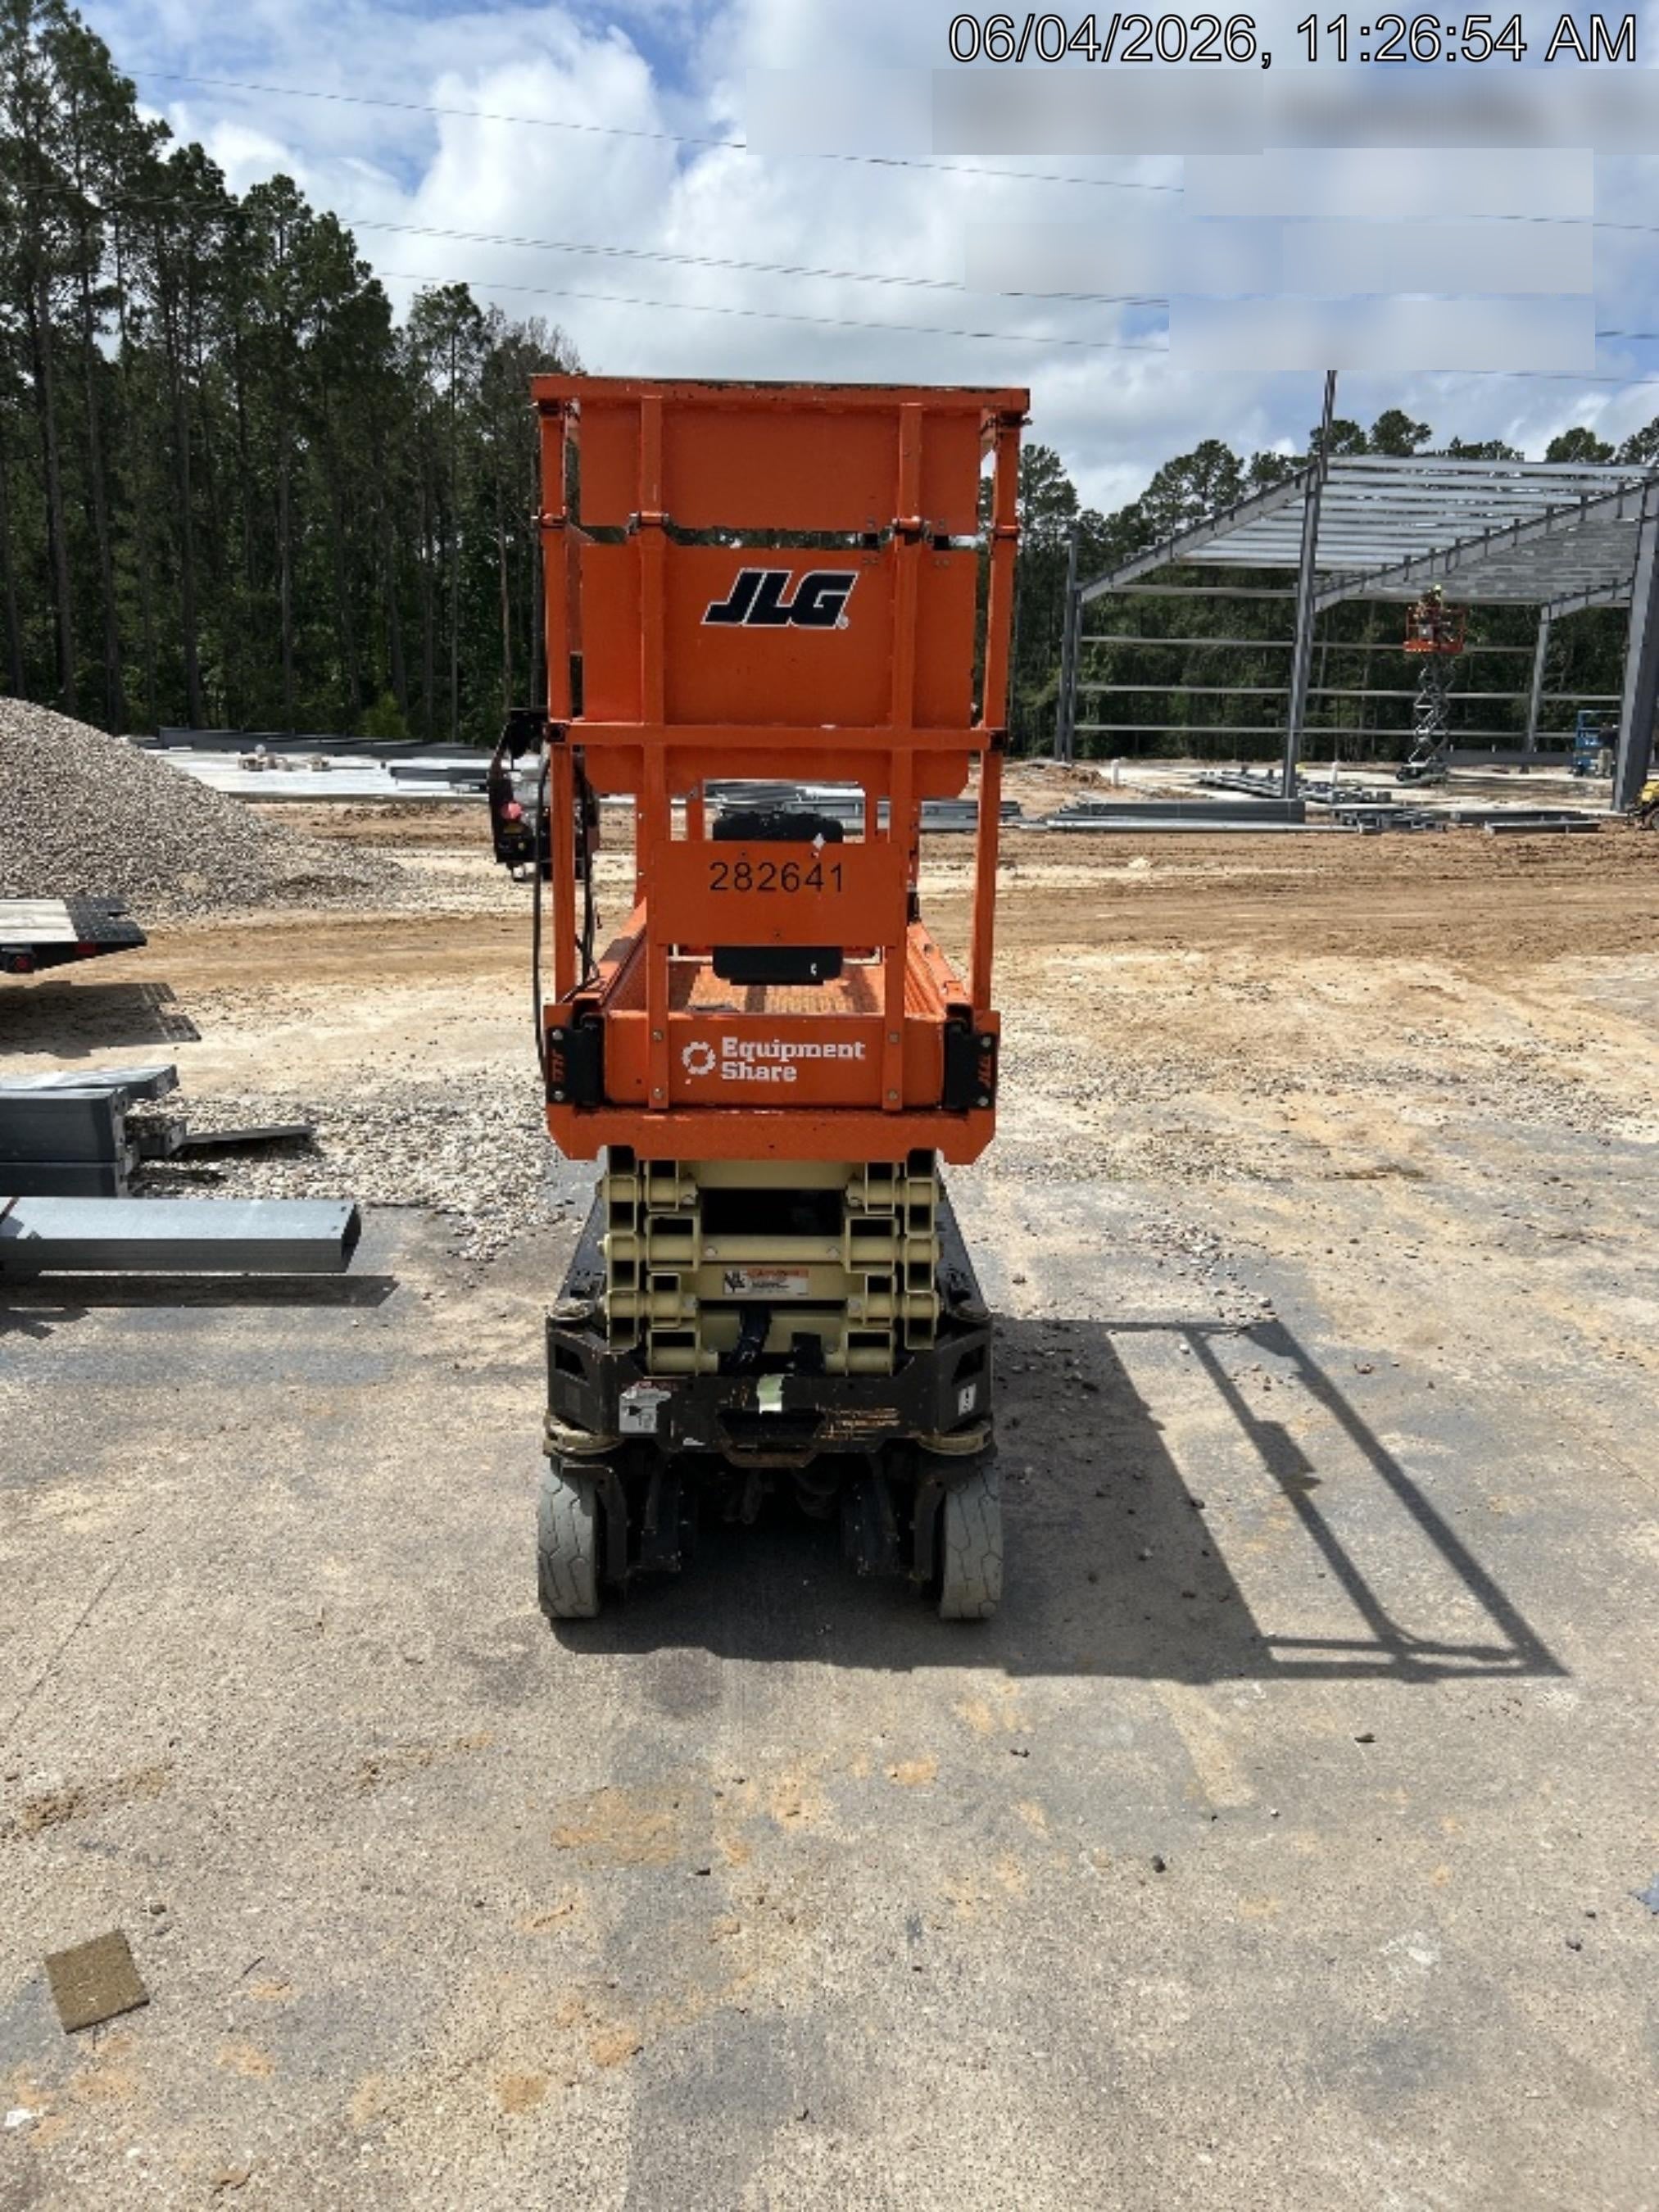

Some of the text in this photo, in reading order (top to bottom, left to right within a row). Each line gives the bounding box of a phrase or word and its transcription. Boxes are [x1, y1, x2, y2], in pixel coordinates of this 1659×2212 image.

[701, 567, 859, 629] JLG
[709, 862, 842, 893] 282641
[722, 1036, 866, 1063] Equipment
[722, 1061, 797, 1082] Share
